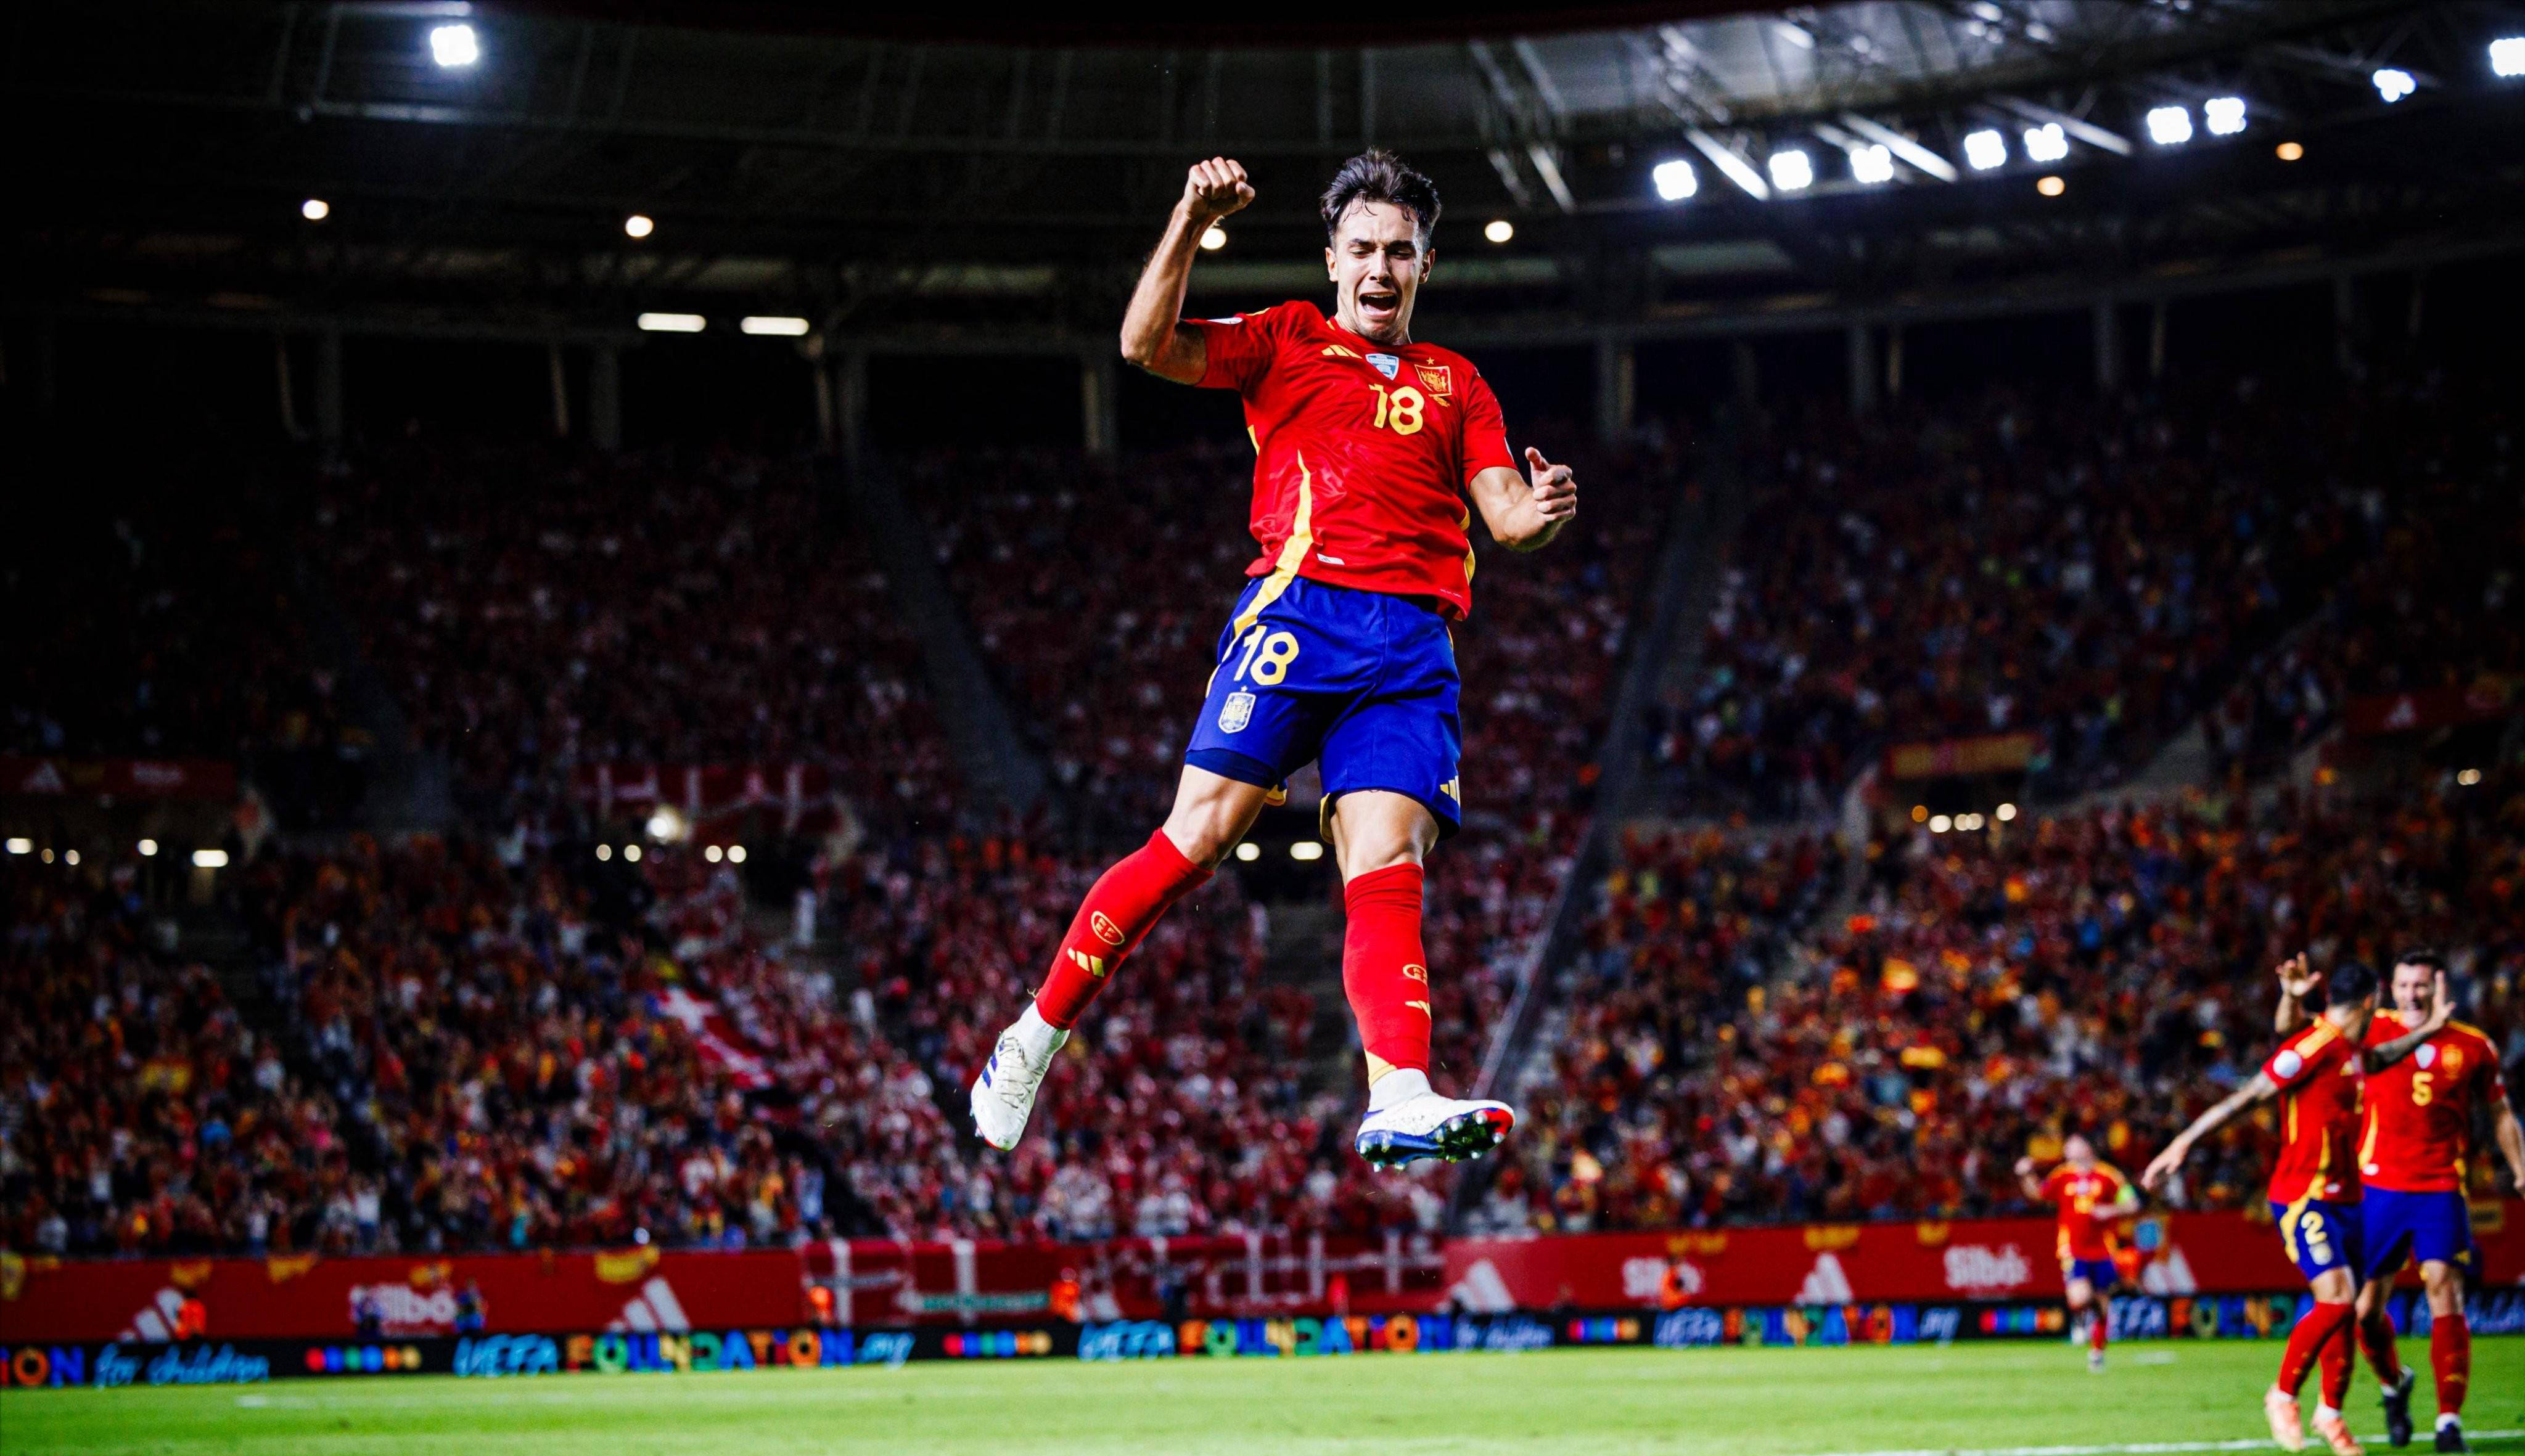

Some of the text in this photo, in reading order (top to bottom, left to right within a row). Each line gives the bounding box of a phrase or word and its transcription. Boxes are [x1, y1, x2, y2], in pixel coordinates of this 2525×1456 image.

[1368, 383, 1424, 435] 18
[1233, 625, 1299, 685] 18
[2412, 1071, 2434, 1106] 5
[2301, 1211, 2327, 1245] 2
